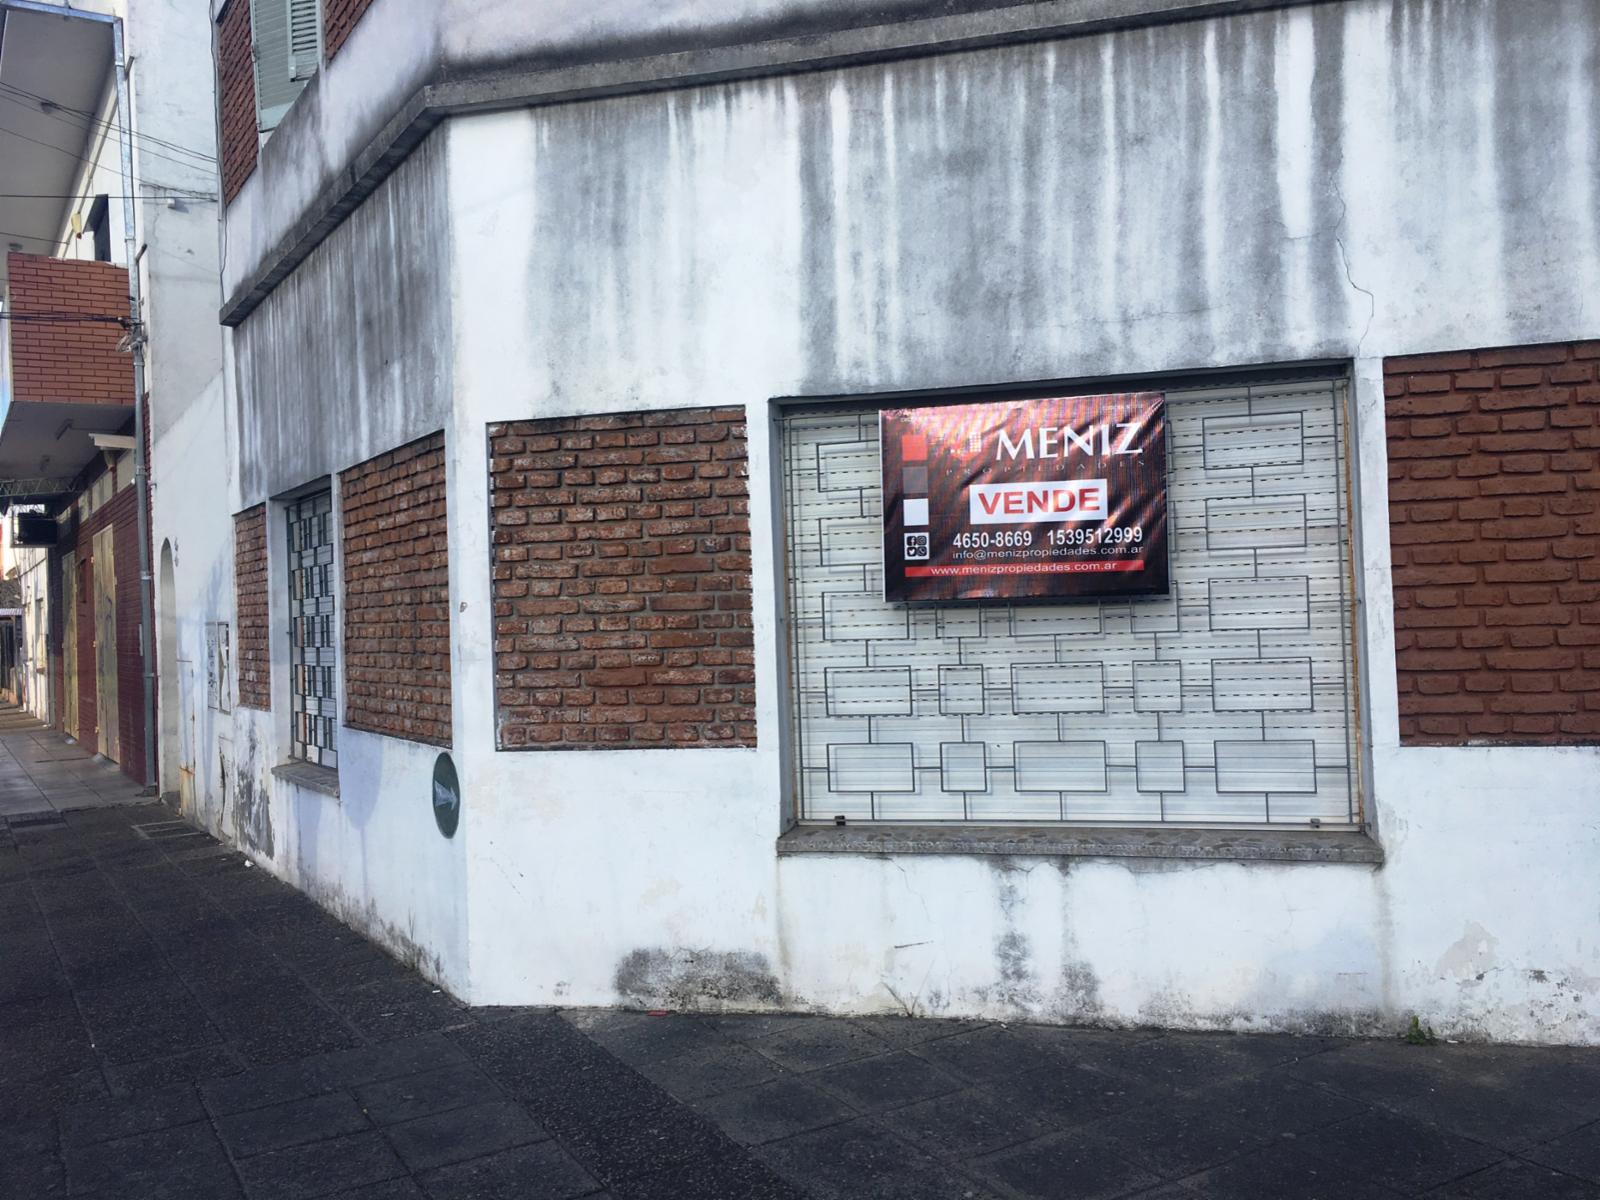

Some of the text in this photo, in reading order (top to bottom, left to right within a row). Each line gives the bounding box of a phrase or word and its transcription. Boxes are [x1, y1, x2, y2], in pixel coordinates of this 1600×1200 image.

[996, 422, 1143, 461] MENIZ
[978, 488, 1100, 515] VENDE
[953, 526, 1143, 548] 4650-8669 1539512999
[952, 546, 1144, 560] info@menizpropiedades.com.ar
[930, 561, 1117, 575] www.menizpropiedades.com.ar
